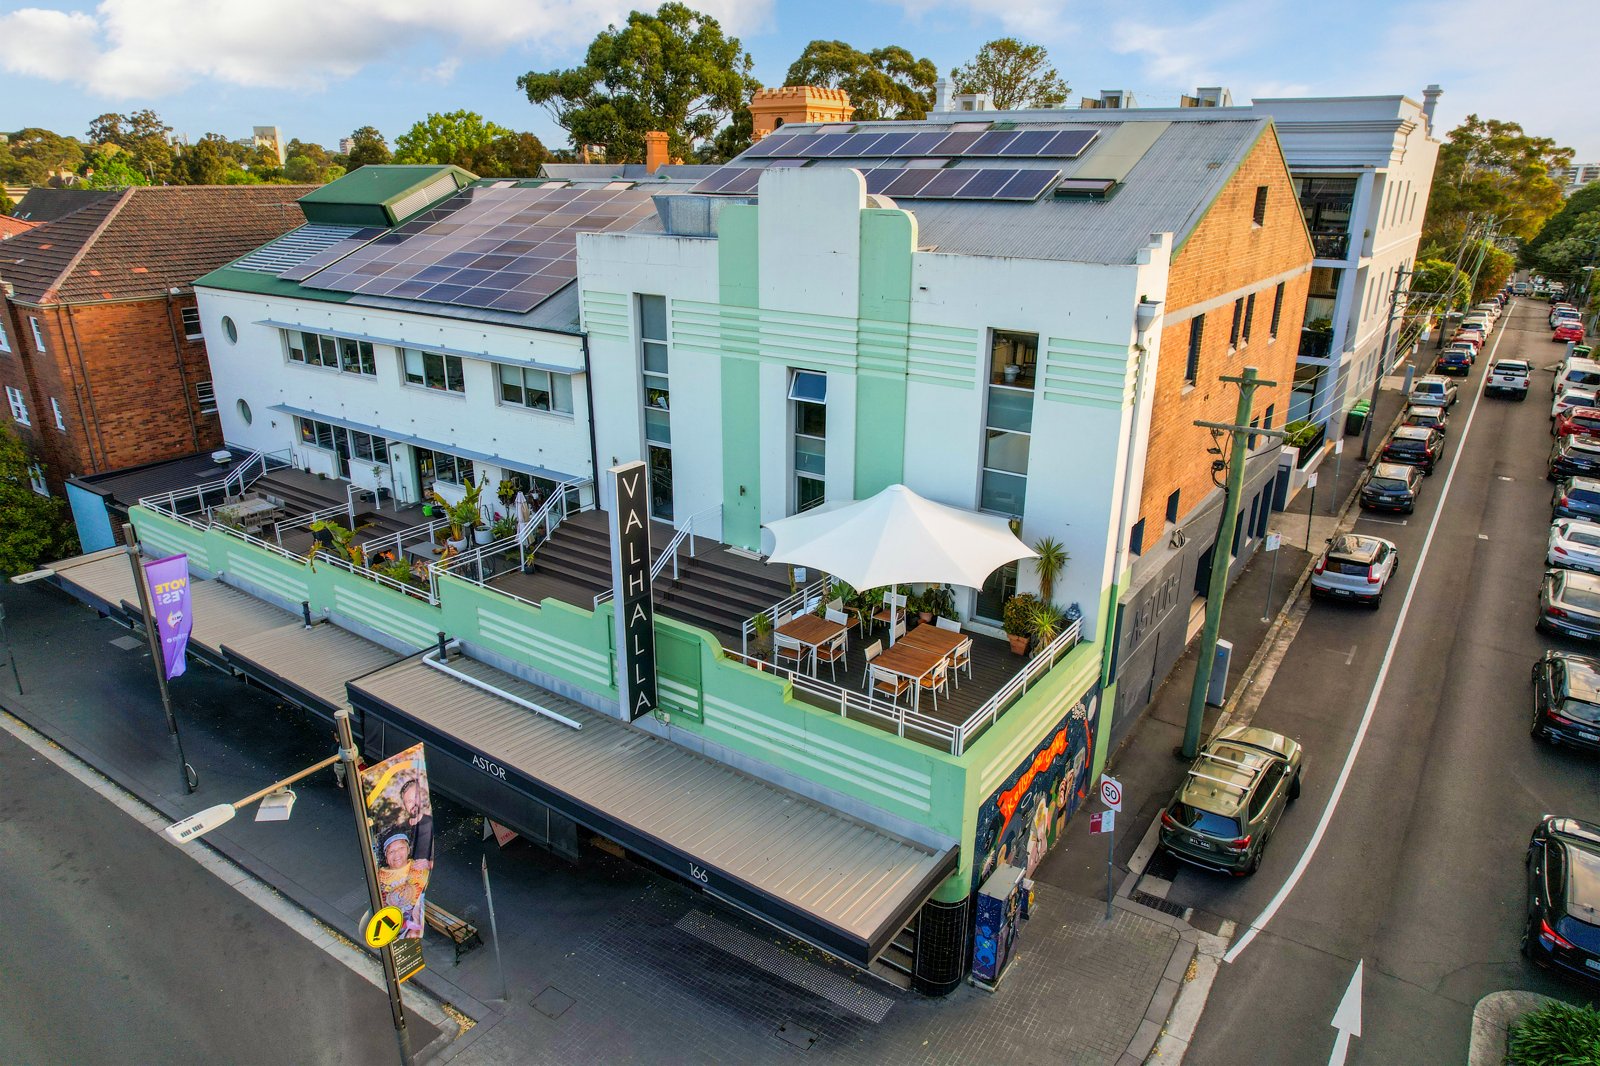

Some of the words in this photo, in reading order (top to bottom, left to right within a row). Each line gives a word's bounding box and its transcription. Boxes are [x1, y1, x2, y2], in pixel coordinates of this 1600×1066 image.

[622, 472, 651, 715] VALHALLA
[472, 754, 507, 781] ASTOR
[1105, 785, 1117, 800] 50
[689, 862, 709, 883] 166
